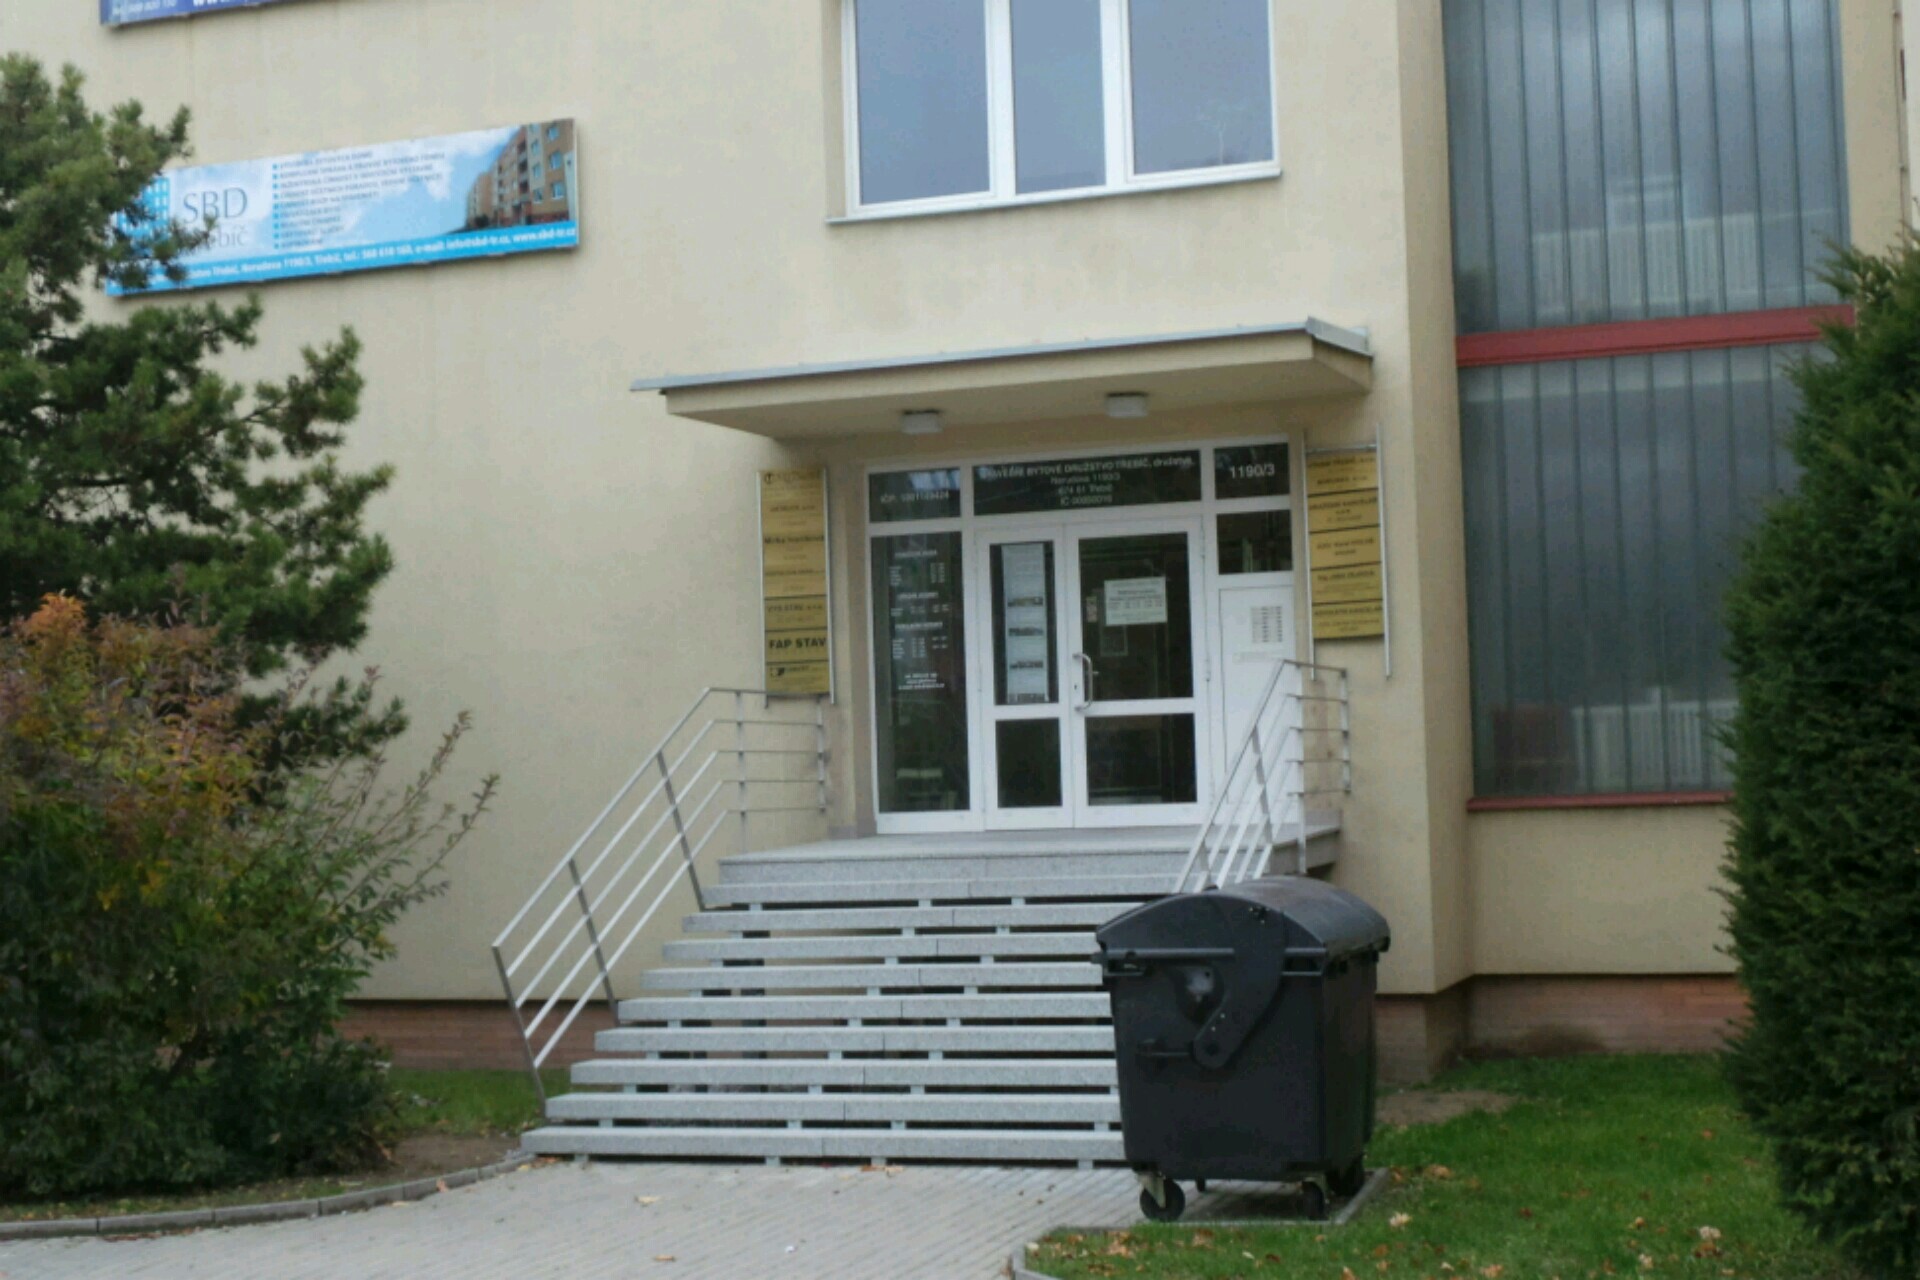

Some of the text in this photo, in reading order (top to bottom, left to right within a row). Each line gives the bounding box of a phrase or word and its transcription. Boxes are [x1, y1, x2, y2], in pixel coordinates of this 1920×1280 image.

[183, 187, 247, 224] SBD
[1230, 463, 1275, 479] 1190/3
[769, 637, 826, 649] FAP STAV
